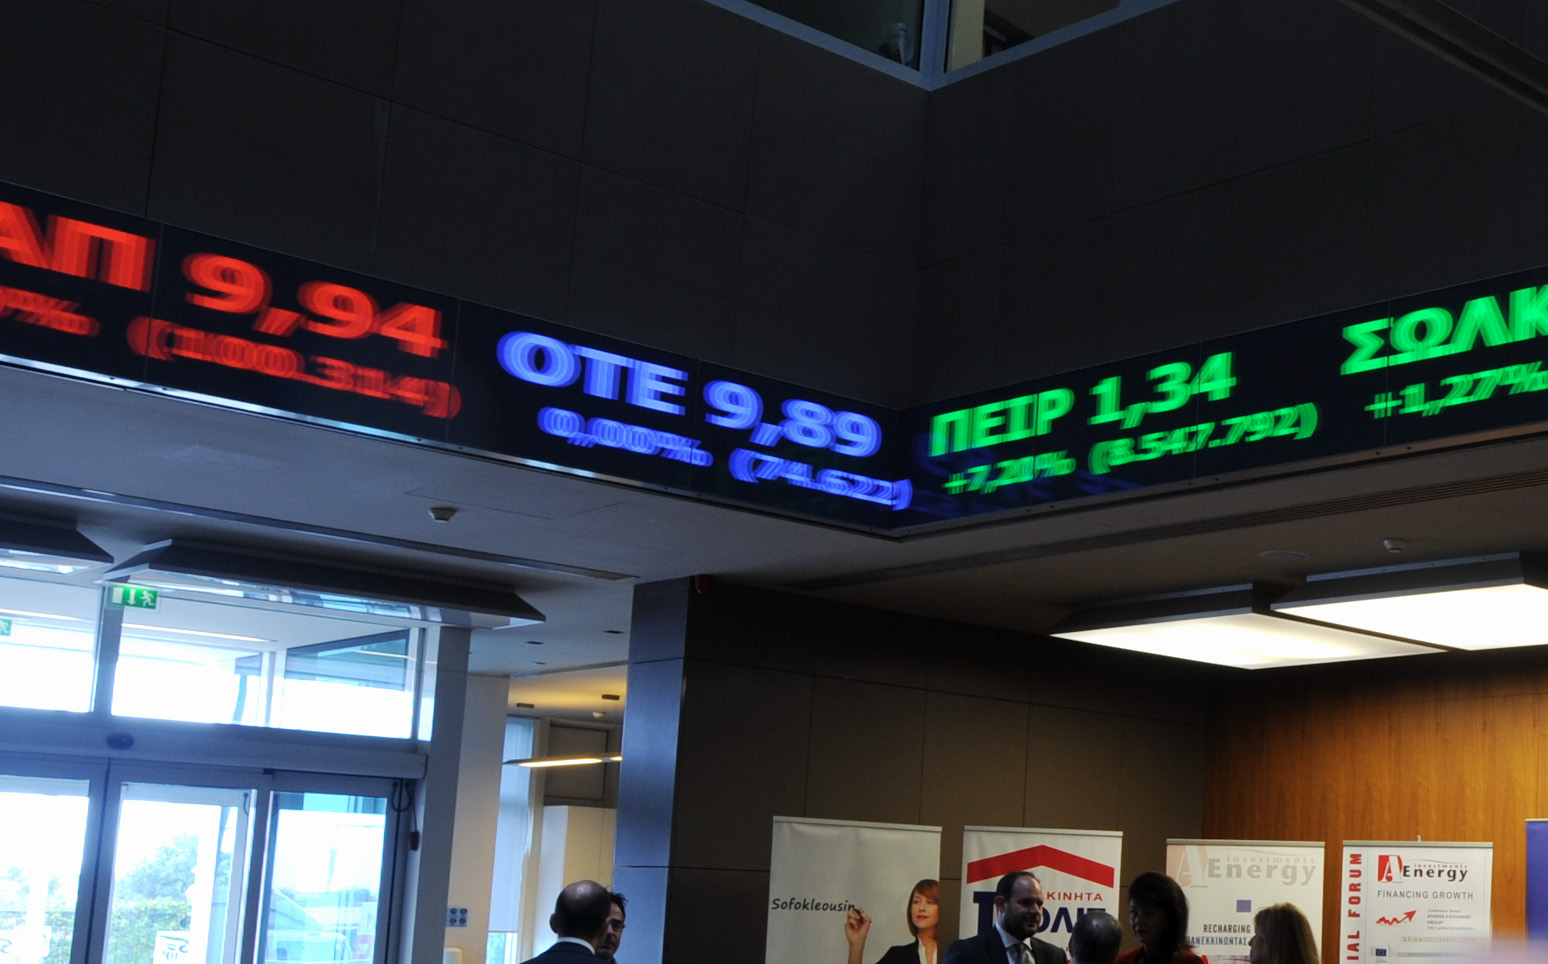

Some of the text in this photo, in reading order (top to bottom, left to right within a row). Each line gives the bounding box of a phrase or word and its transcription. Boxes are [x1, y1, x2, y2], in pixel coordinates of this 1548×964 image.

[183, 252, 448, 357] 9,94
[1087, 351, 1237, 430] 1,34
[703, 379, 882, 457] 9,89
[537, 406, 714, 467] 0,00%
[1227, 854, 1316, 864] investments
[1208, 858, 1316, 886] Energy
[1403, 865, 1468, 882] Energy
[1043, 891, 1103, 901] ΚΙΝΗΤΑ
[1348, 854, 1362, 918] FORUM
[1377, 890, 1474, 900] FINANCING GROWTH
[772, 898, 857, 914] Sofokleousin
[1203, 924, 1251, 933] RECHARGING
